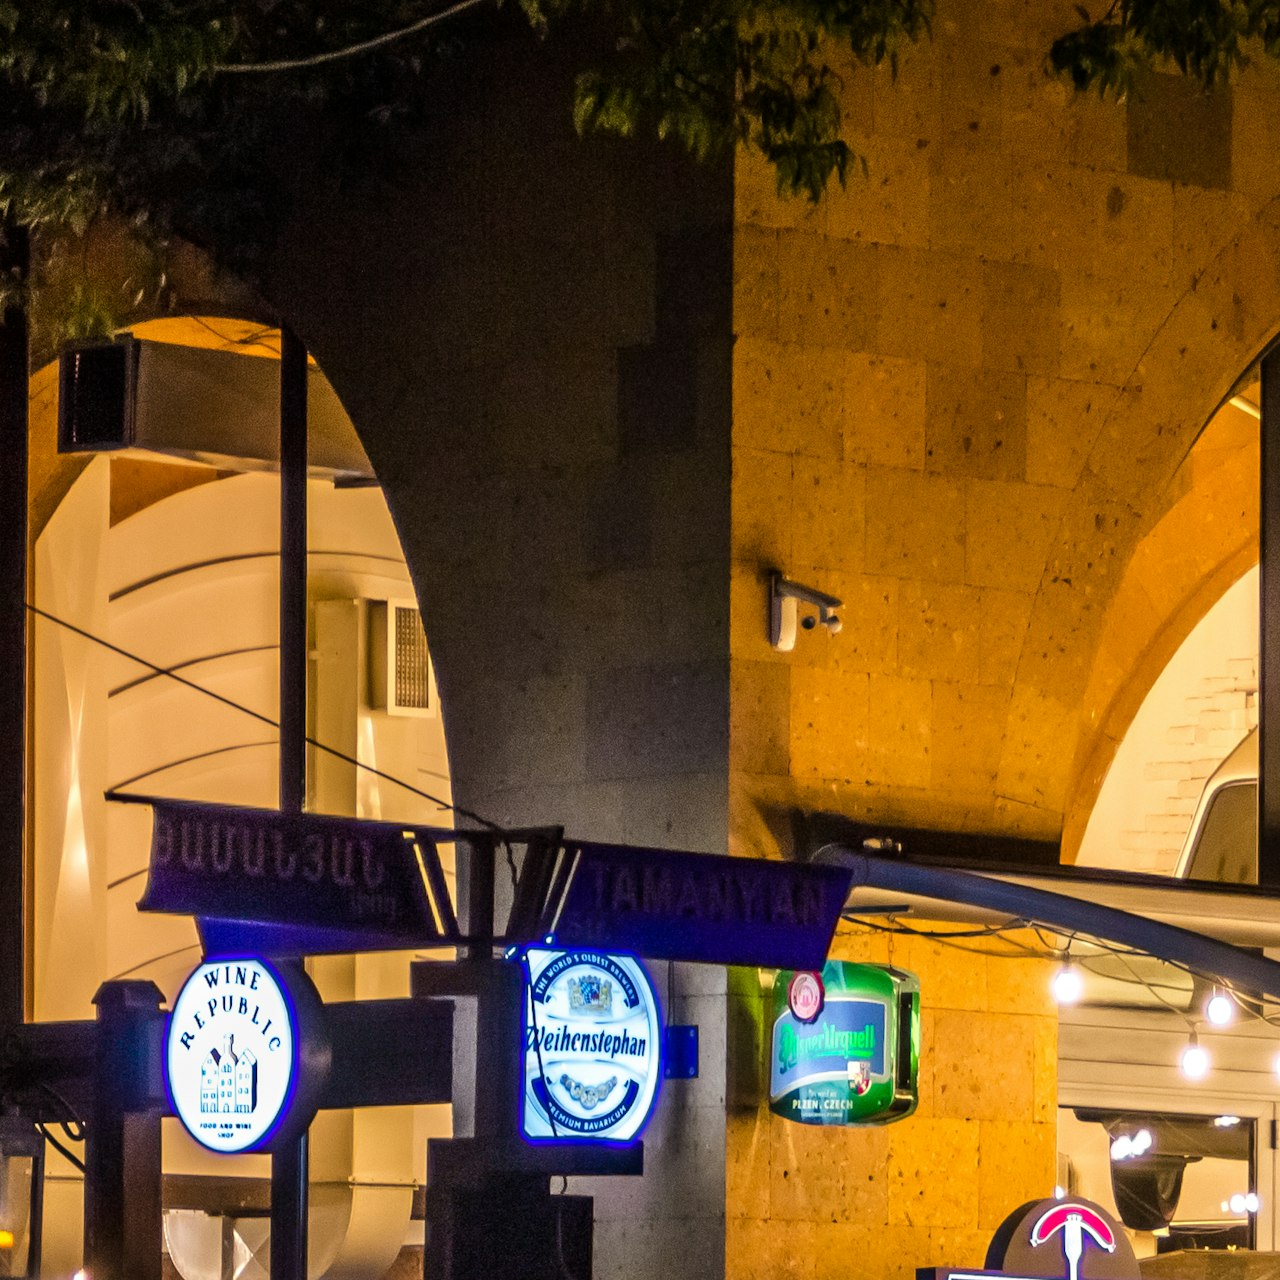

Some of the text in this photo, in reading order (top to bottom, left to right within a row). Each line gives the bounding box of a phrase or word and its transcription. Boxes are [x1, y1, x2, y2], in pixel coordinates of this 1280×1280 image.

[589, 859, 829, 926] TAMANYAN
[204, 966, 261, 990] WINE
[536, 953, 636, 1001] THE WORLD'S OLDEST BREWERY
[180, 995, 281, 1052] REPUBLIC
[822, 1021, 875, 1059] Urquell
[526, 1026, 646, 1058] Weihenstephan
[584, 1105, 627, 1131] BAVARICUM
[824, 1099, 853, 1110] CZECH
